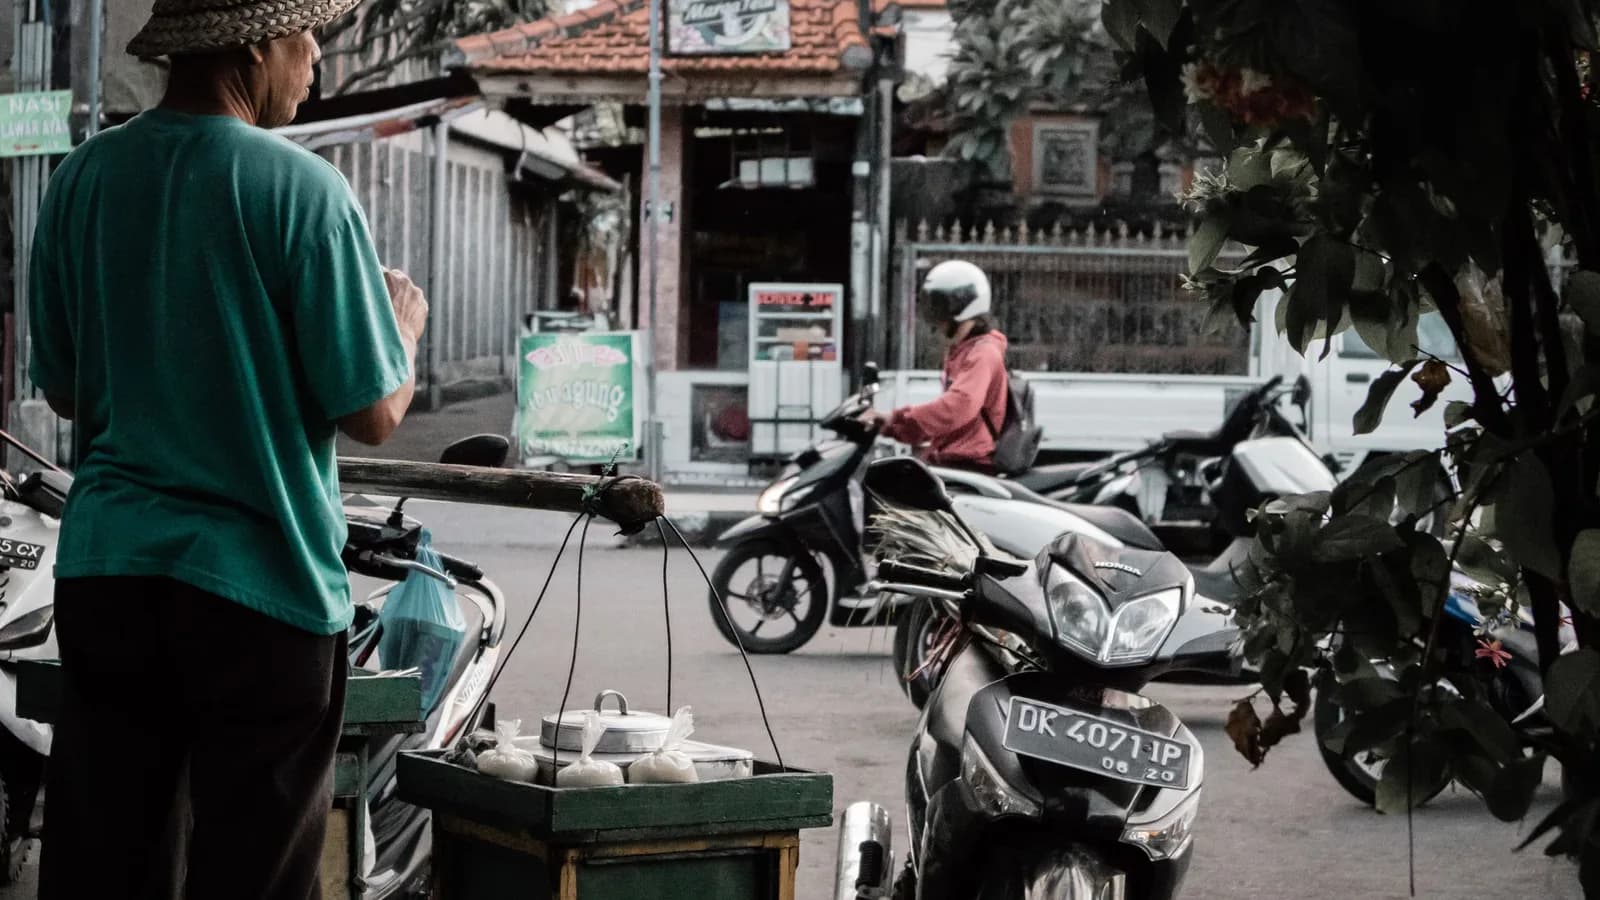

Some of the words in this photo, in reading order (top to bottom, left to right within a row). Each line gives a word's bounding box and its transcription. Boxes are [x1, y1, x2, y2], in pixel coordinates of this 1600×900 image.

[9, 96, 60, 114] NASI
[560, 380, 625, 422] agung
[0, 540, 12, 552] 5
[16, 543, 40, 558] CX
[20, 559, 36, 569] 20
[1095, 561, 1142, 576] HONDA
[1017, 704, 1056, 737] DK
[1066, 720, 1141, 759] 4071
[1150, 741, 1182, 766] IP
[1145, 767, 1175, 782] 20
